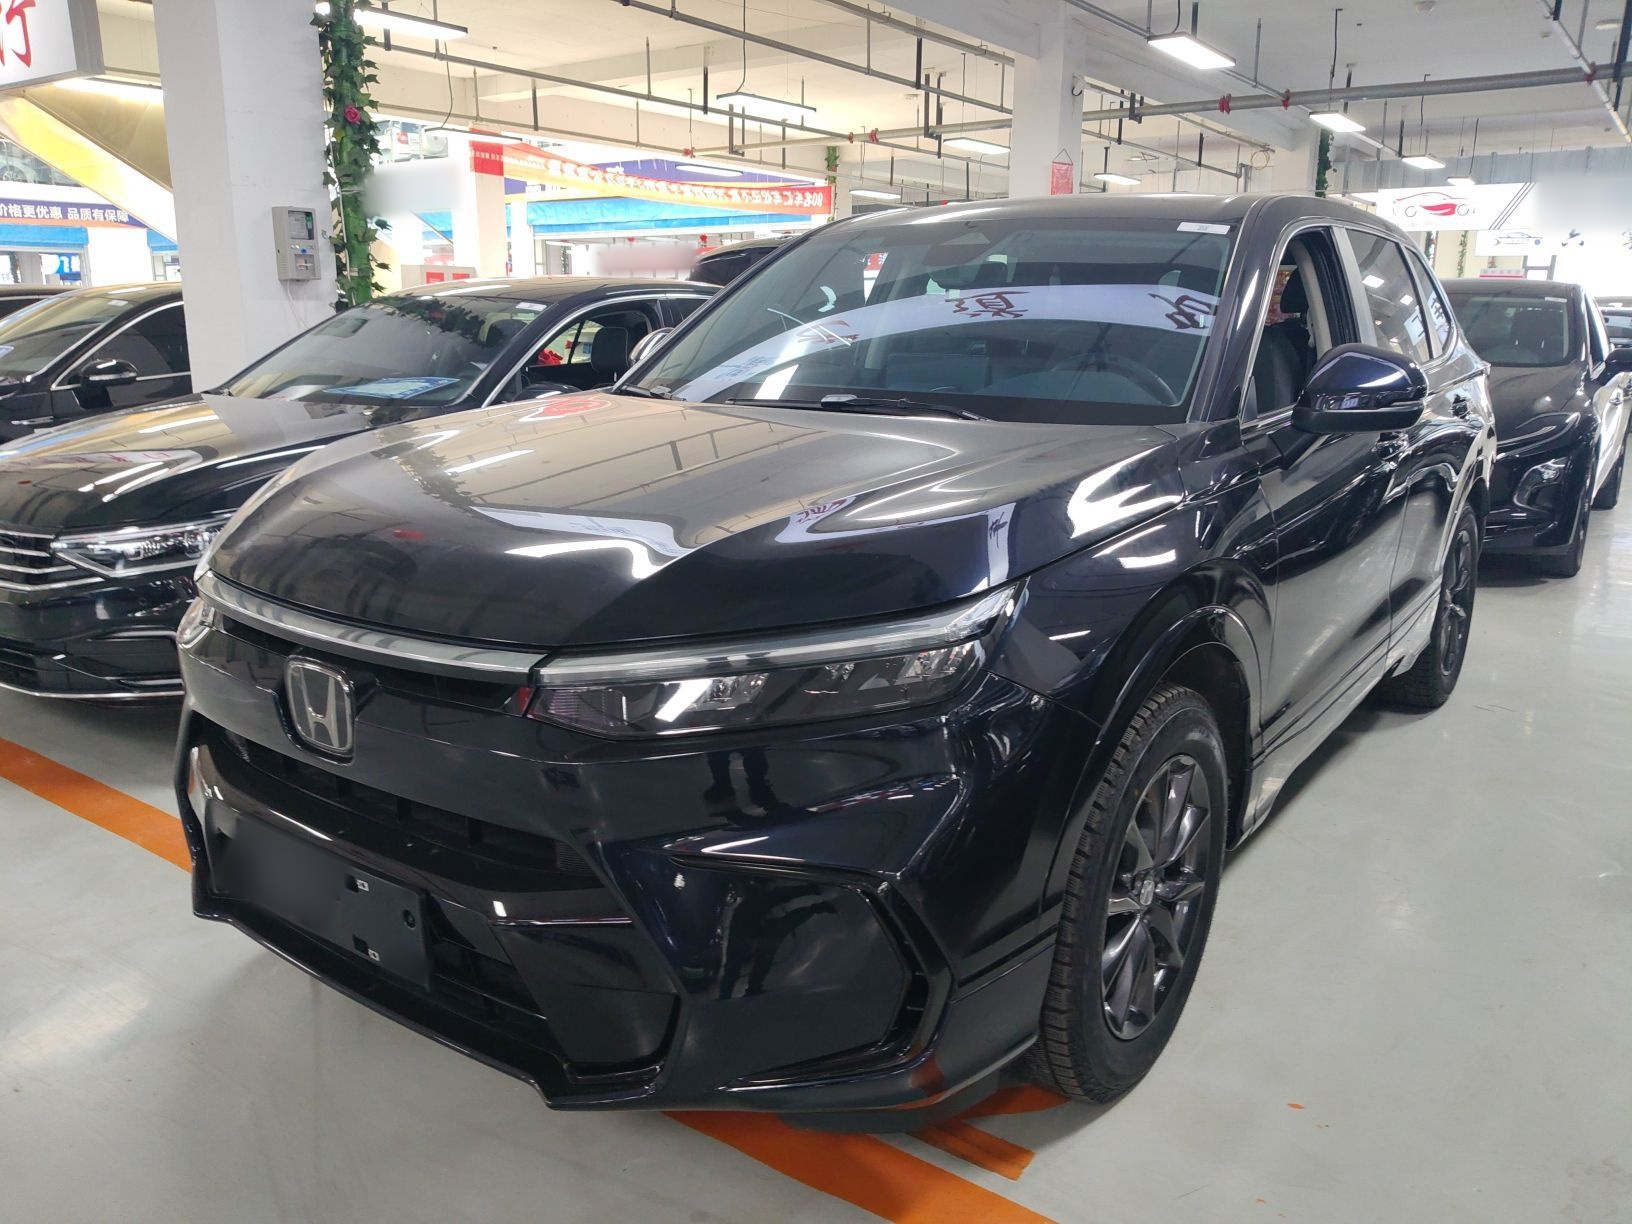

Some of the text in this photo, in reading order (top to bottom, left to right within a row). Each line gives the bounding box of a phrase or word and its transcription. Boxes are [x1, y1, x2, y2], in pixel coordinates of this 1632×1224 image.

[67, 207, 130, 223] 品质有保障
